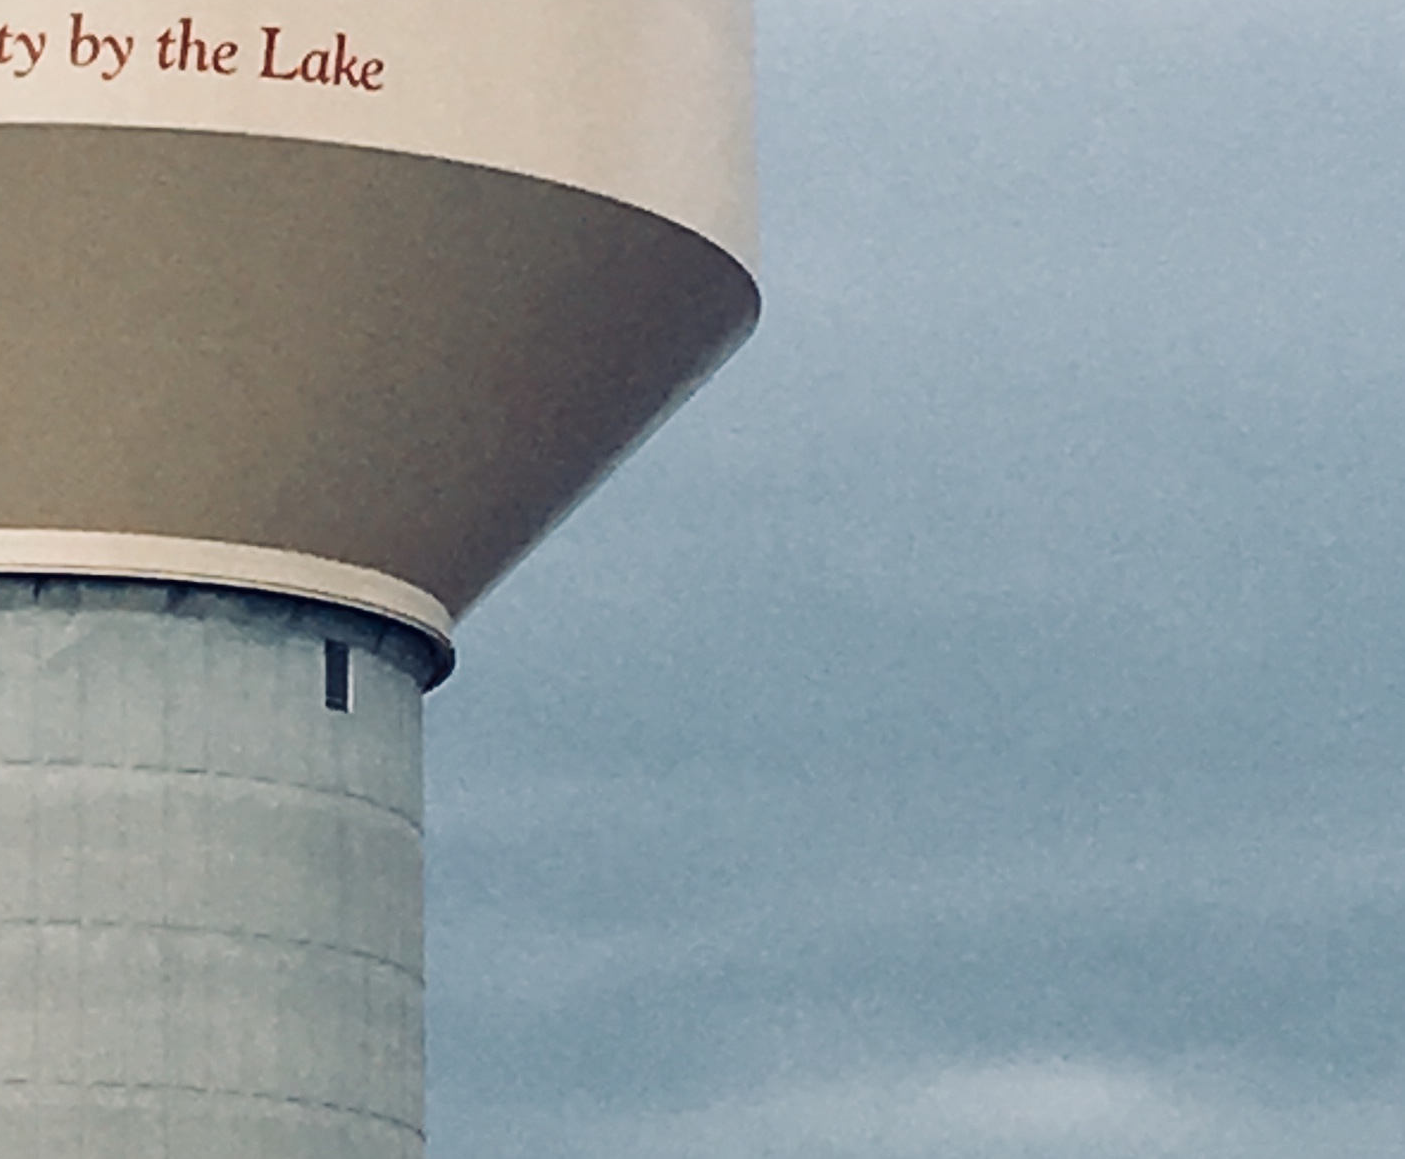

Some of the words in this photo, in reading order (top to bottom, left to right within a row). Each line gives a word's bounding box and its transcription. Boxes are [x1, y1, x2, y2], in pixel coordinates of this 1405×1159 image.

[68, 12, 134, 82] by
[158, 17, 238, 77] the
[261, 26, 385, 92] Lake
